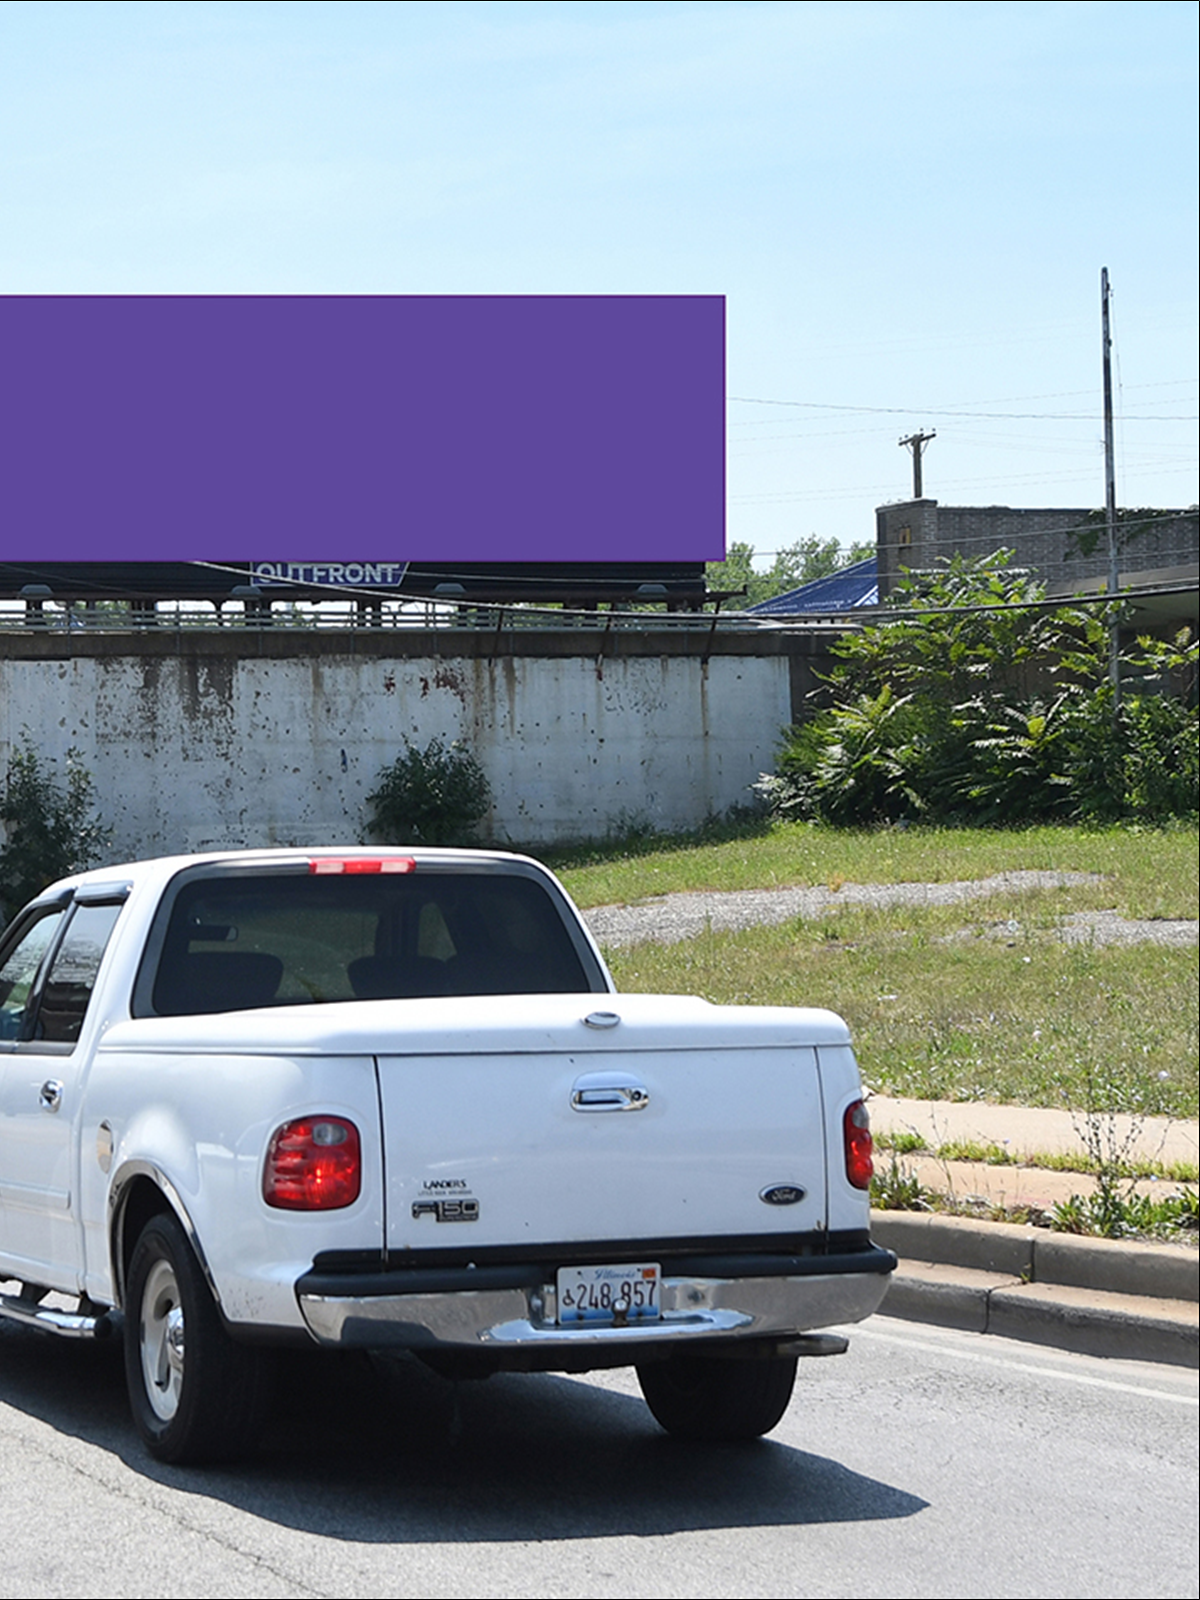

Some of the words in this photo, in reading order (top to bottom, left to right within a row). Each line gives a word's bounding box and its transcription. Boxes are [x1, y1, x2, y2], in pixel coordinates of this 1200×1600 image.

[256, 562, 400, 583] OUTFRONT
[423, 1179, 467, 1190] LANDERS
[577, 1282, 611, 1310] 248
[621, 1281, 656, 1308] 857
